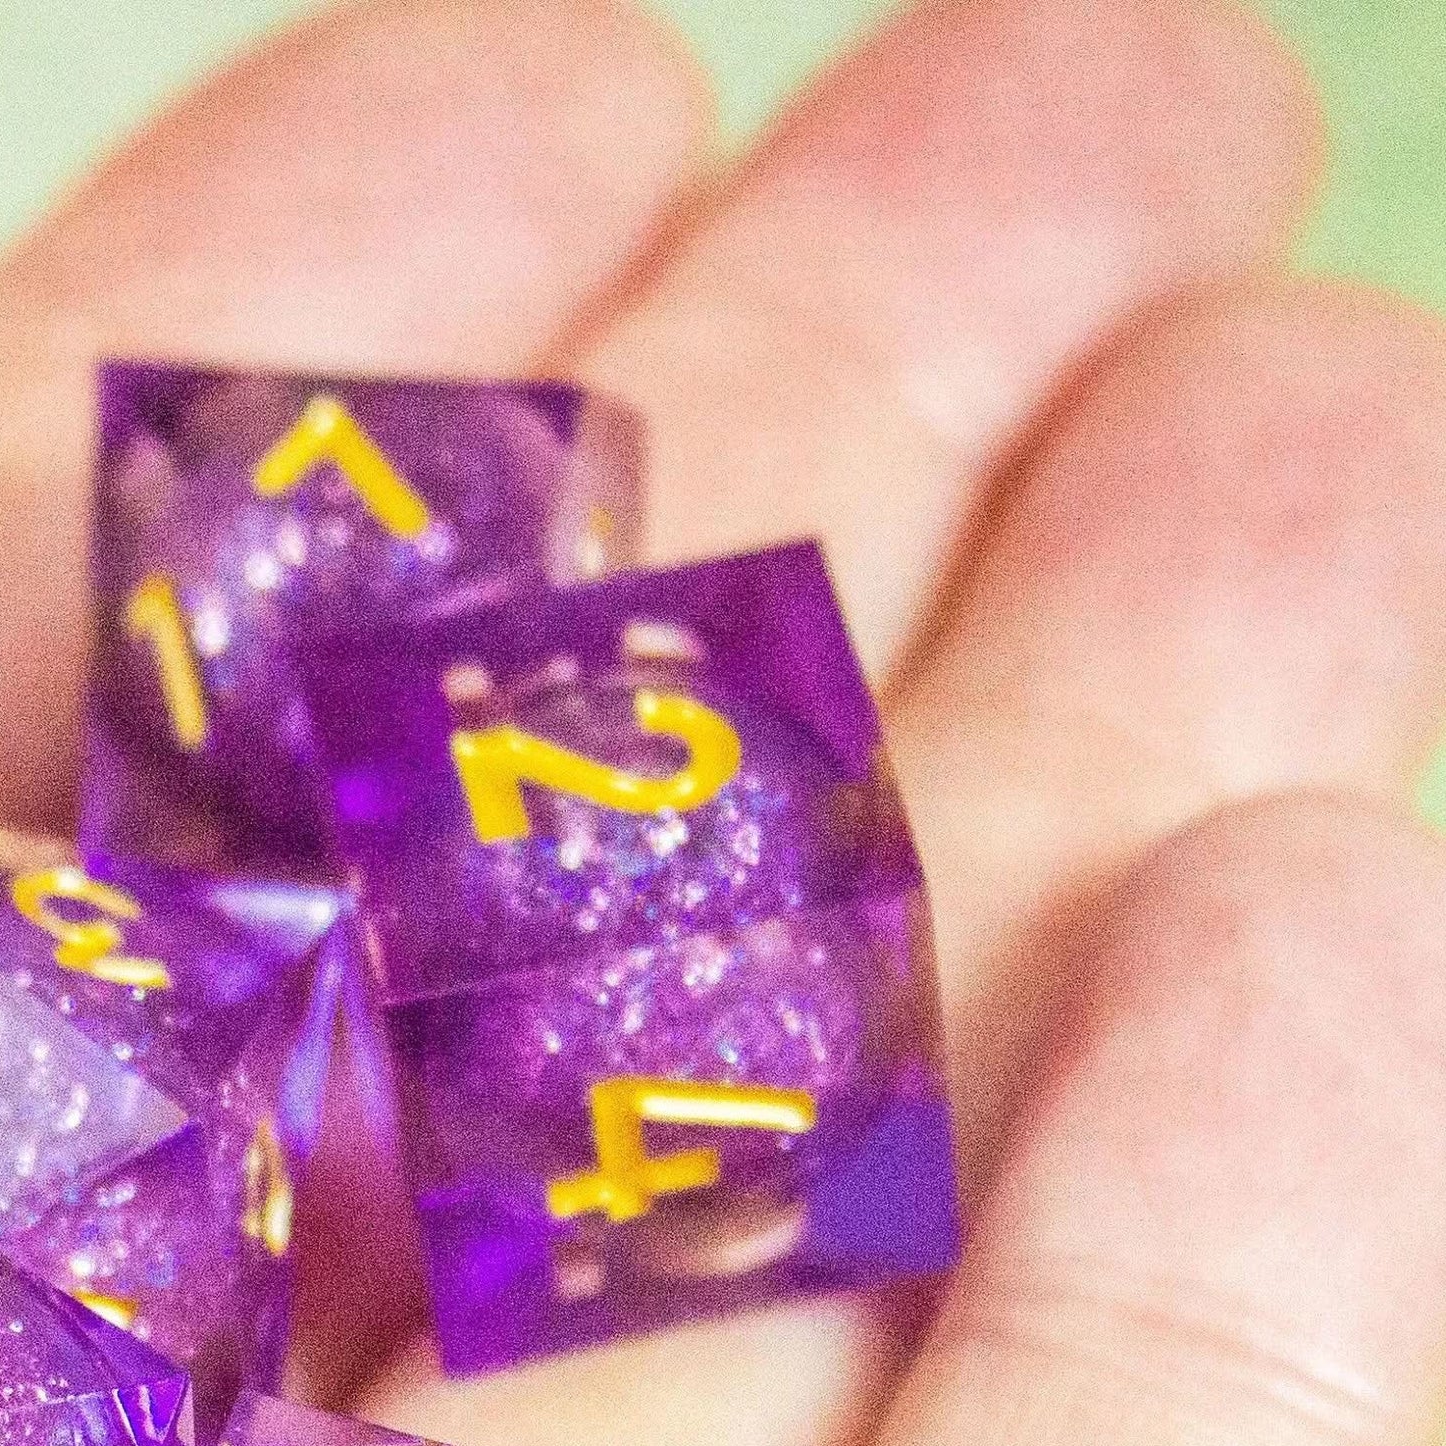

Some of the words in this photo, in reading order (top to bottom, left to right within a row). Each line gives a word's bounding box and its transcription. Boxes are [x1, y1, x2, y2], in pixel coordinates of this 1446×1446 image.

[128, 576, 208, 748] 1
[451, 691, 741, 845] 2
[11, 866, 172, 990] 3
[548, 1077, 817, 1223] 4
